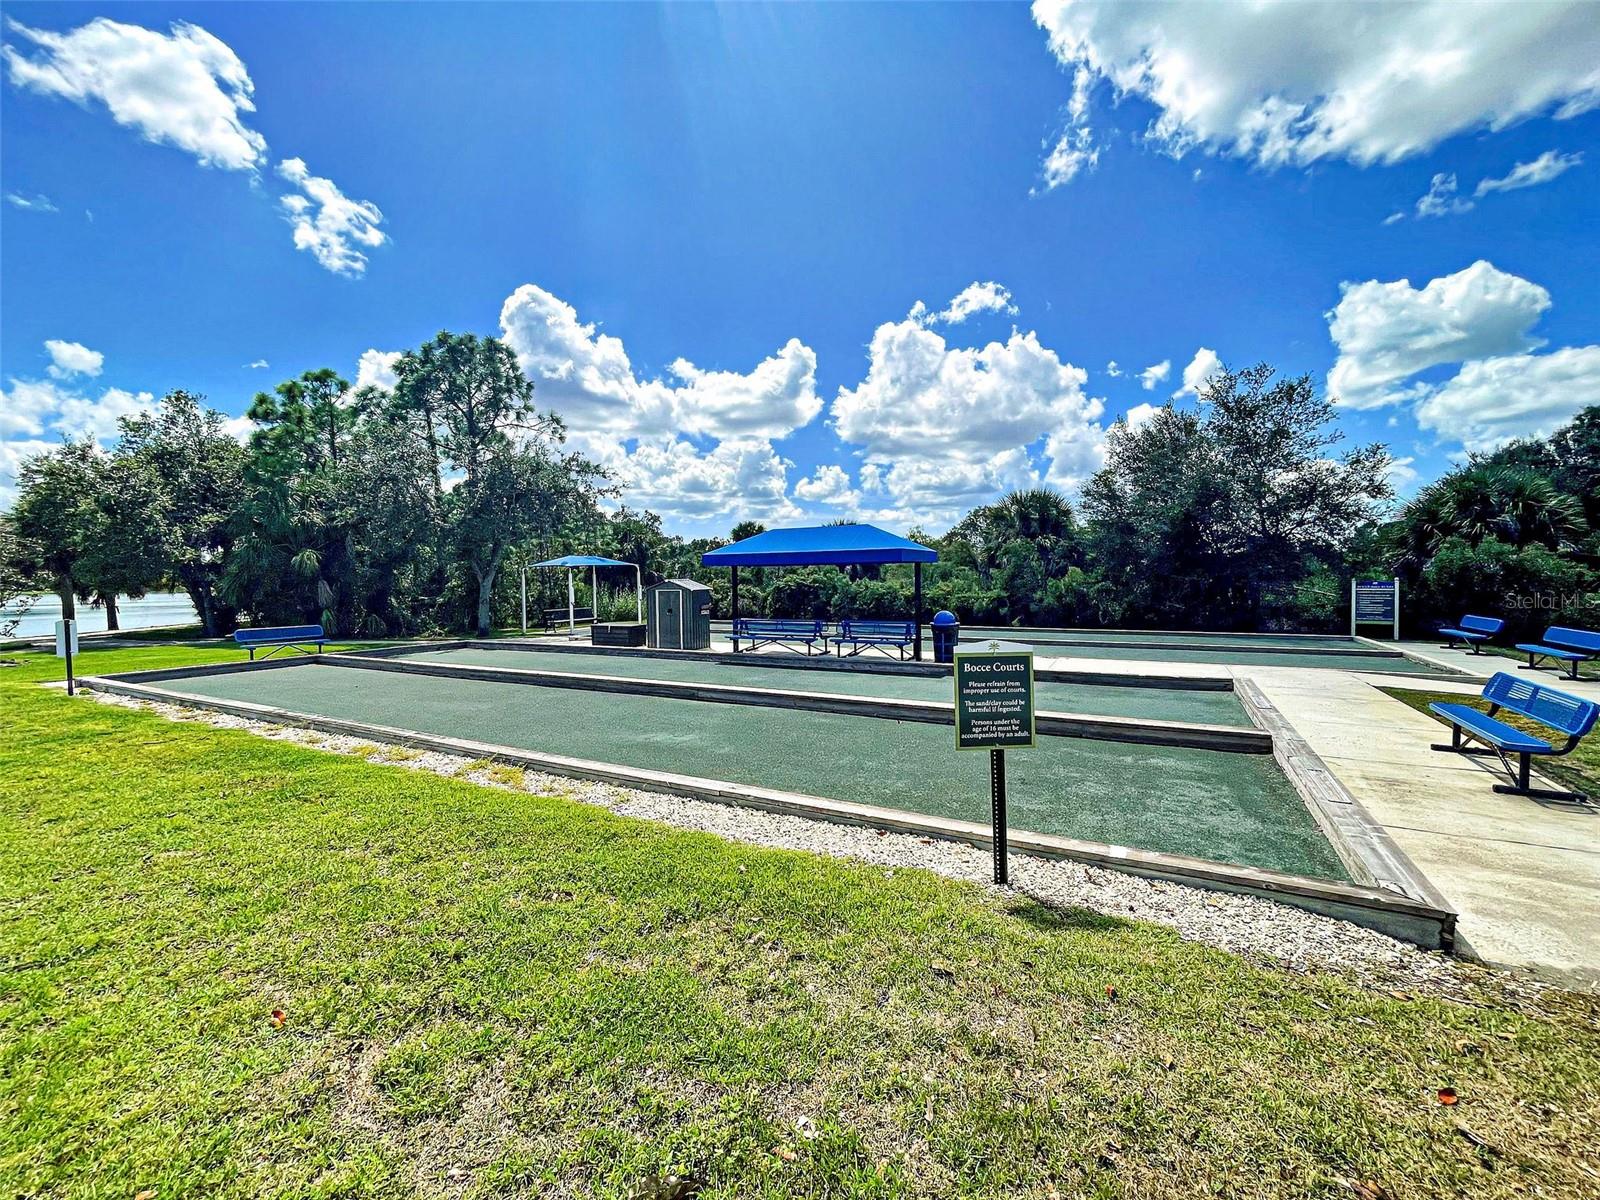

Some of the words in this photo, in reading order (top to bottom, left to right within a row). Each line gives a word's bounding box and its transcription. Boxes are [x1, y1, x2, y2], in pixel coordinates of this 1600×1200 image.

[963, 663, 991, 672] Bocce
[993, 662, 1025, 671] Courts
[961, 731, 997, 739] accompanied
